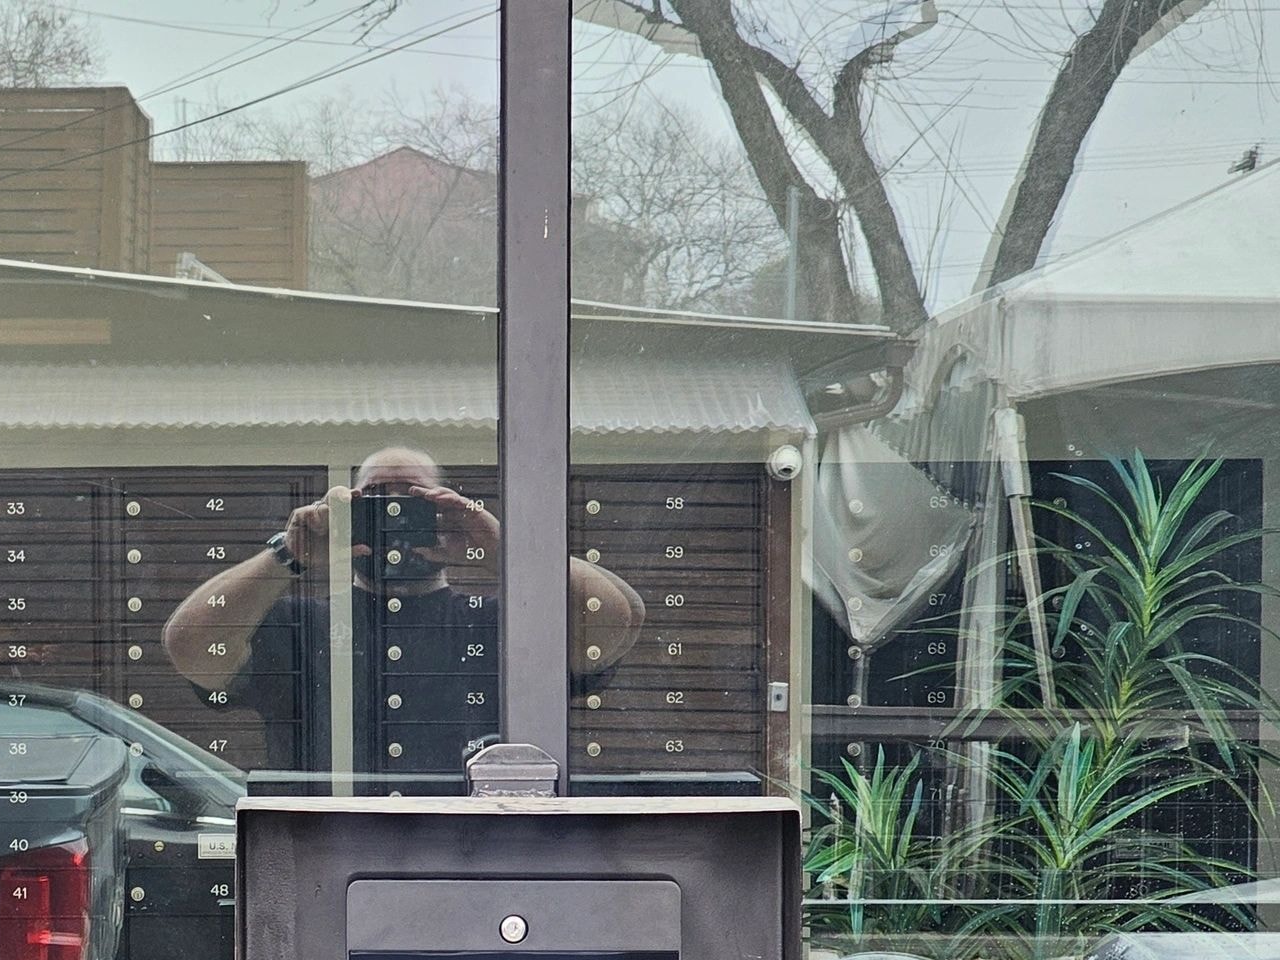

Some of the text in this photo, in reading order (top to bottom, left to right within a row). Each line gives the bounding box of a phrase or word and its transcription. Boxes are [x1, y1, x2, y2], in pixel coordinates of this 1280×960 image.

[6, 502, 25, 515] 33
[205, 498, 225, 511] 42
[465, 499, 485, 512] 49
[665, 496, 685, 510] 58
[929, 495, 949, 509] 65
[7, 549, 26, 563] 34
[206, 546, 226, 560] 43
[466, 547, 485, 560] 50
[665, 545, 684, 559] 59
[928, 544, 949, 558] 66
[7, 598, 26, 611] 35
[207, 594, 226, 608] 44
[468, 595, 483, 609] 51
[665, 593, 685, 607] 60
[928, 593, 947, 606] 67
[8, 645, 27, 658] 36
[207, 642, 227, 656] 45
[466, 643, 485, 657] 52
[667, 642, 682, 656] 61
[927, 641, 947, 655] 68
[8, 694, 26, 707] 37
[208, 691, 228, 704] 46
[465, 692, 485, 705] 53
[666, 691, 684, 704] 62
[927, 691, 946, 704] 69
[9, 742, 28, 755] 38
[208, 739, 228, 752] 47
[466, 739, 486, 752] 54
[665, 739, 684, 753] 63
[8, 790, 28, 804] 39
[928, 787, 943, 801] 71
[9, 838, 29, 852] 40
[208, 842, 229, 851] U.S.
[12, 886, 27, 900] 41
[210, 883, 229, 897] 48
